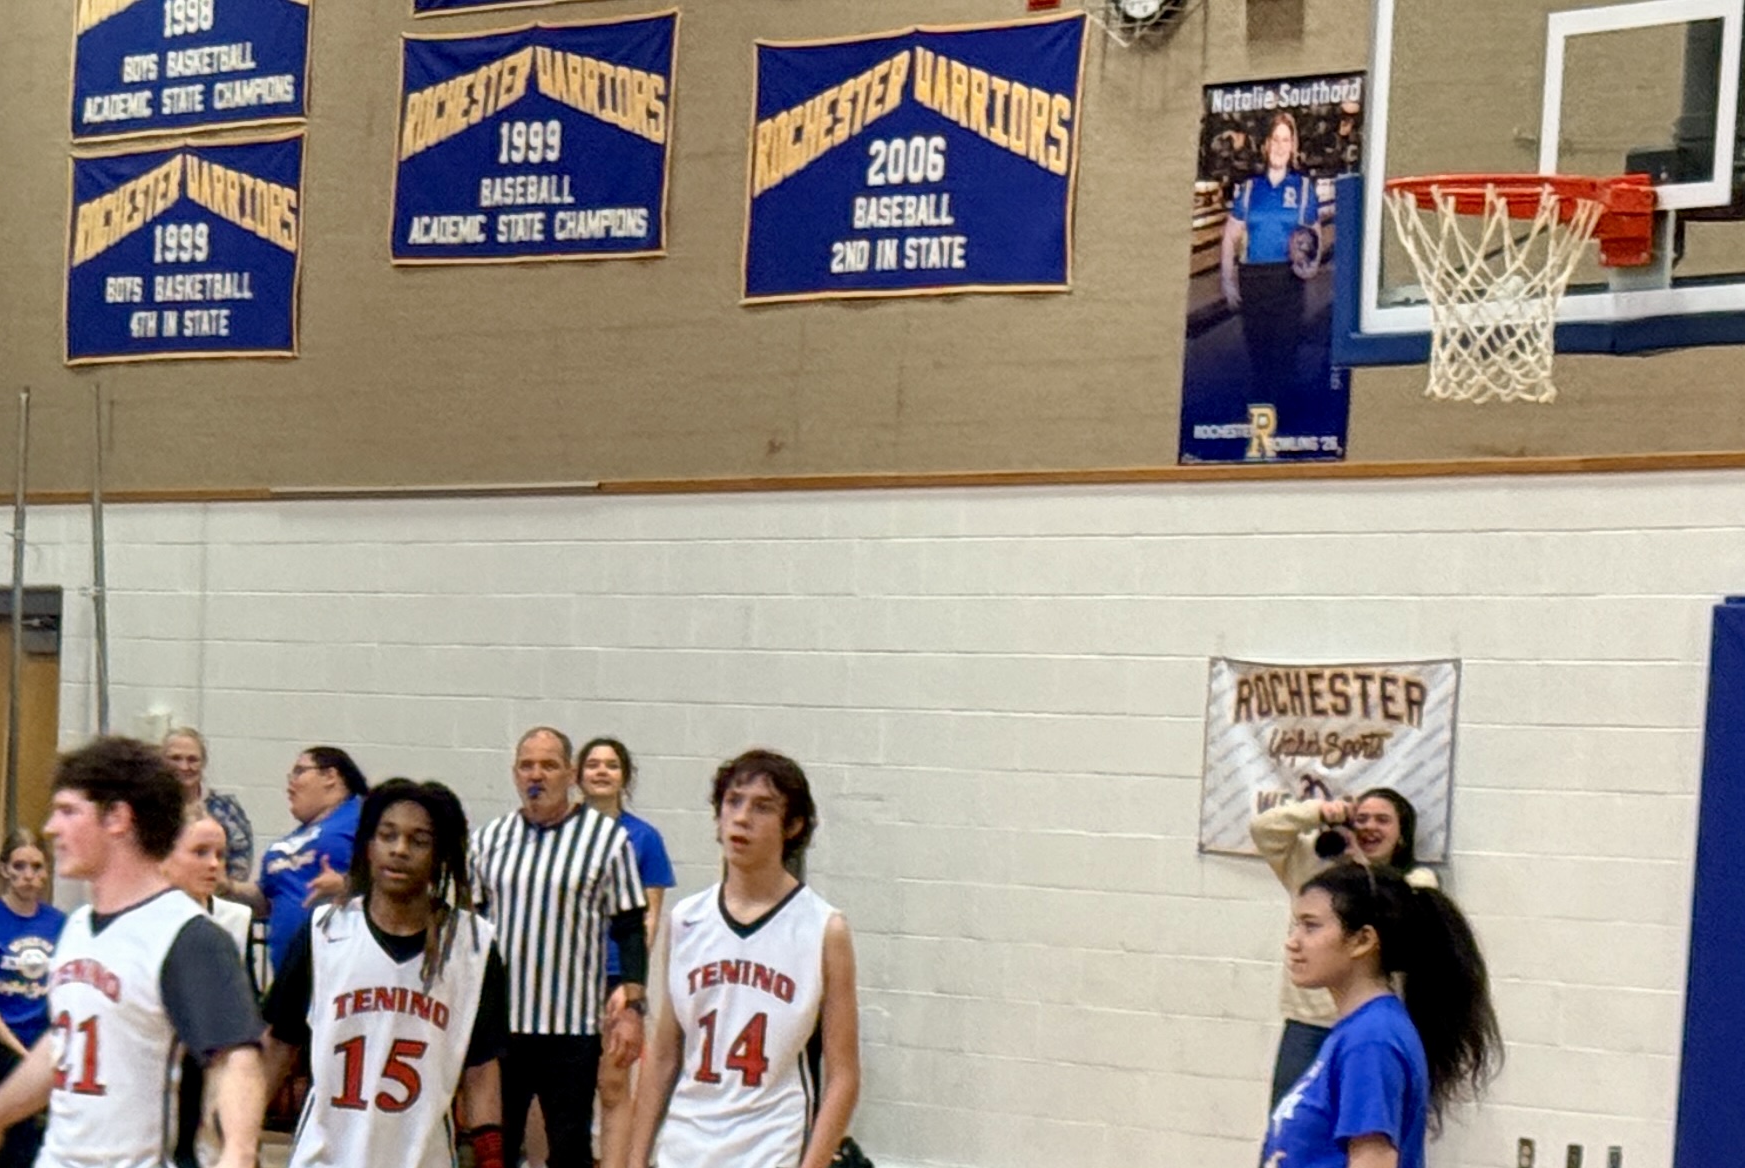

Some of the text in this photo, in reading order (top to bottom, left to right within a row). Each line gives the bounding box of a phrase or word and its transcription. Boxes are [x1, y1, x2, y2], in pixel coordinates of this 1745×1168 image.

[163, 0, 214, 38] 1998
[122, 41, 256, 83] BOYS BASKETBALL
[82, 74, 296, 123] ACADEMIC STATE CHAMPIONS
[400, 45, 666, 162] ROCHESTER WARRIORS
[498, 119, 562, 164] 1999
[753, 45, 1072, 198] ROCHESTER WARRIORS
[867, 136, 947, 186] 2006
[72, 152, 298, 268] ROCHESTER WARRIORS
[480, 174, 576, 207] BASEBALL
[852, 194, 955, 230] BASEBALL
[154, 222, 210, 264] 1999
[407, 207, 650, 244] ACADEMIC STATE CHAMPIONS
[830, 236, 968, 273] 2ND IN STATE
[105, 271, 253, 304] BOYS BASKETBALL
[130, 308, 231, 338] 4TH IN STATE
[1234, 669, 1428, 728] ROCHESTER
[1321, 730, 1393, 769] Sports
[687, 959, 796, 1004] TENINO
[333, 986, 449, 1031] TENINO
[694, 1008, 769, 1087] 14
[330, 1035, 429, 1113] 15
